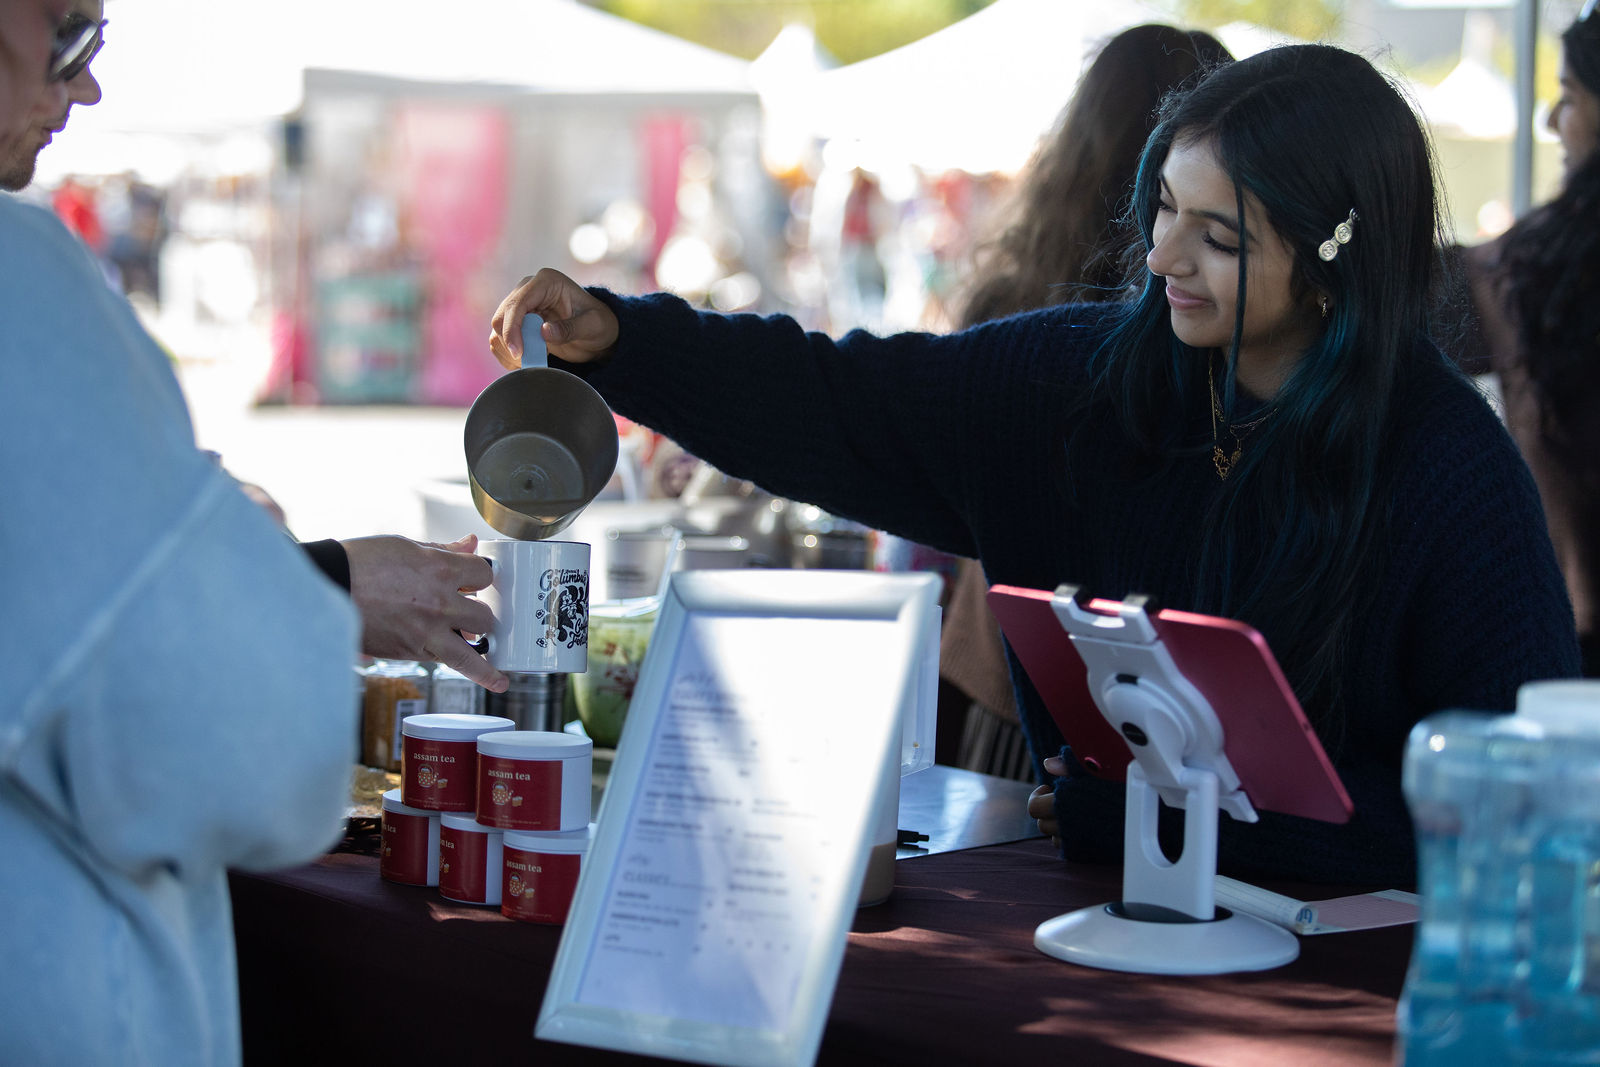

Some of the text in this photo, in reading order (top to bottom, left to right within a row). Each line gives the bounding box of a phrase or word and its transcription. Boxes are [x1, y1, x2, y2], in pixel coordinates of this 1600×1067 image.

[413, 752, 455, 763] assam tea
[488, 769, 531, 781] assam tea
[445, 840, 455, 849] tea
[506, 859, 542, 873] assam tea
